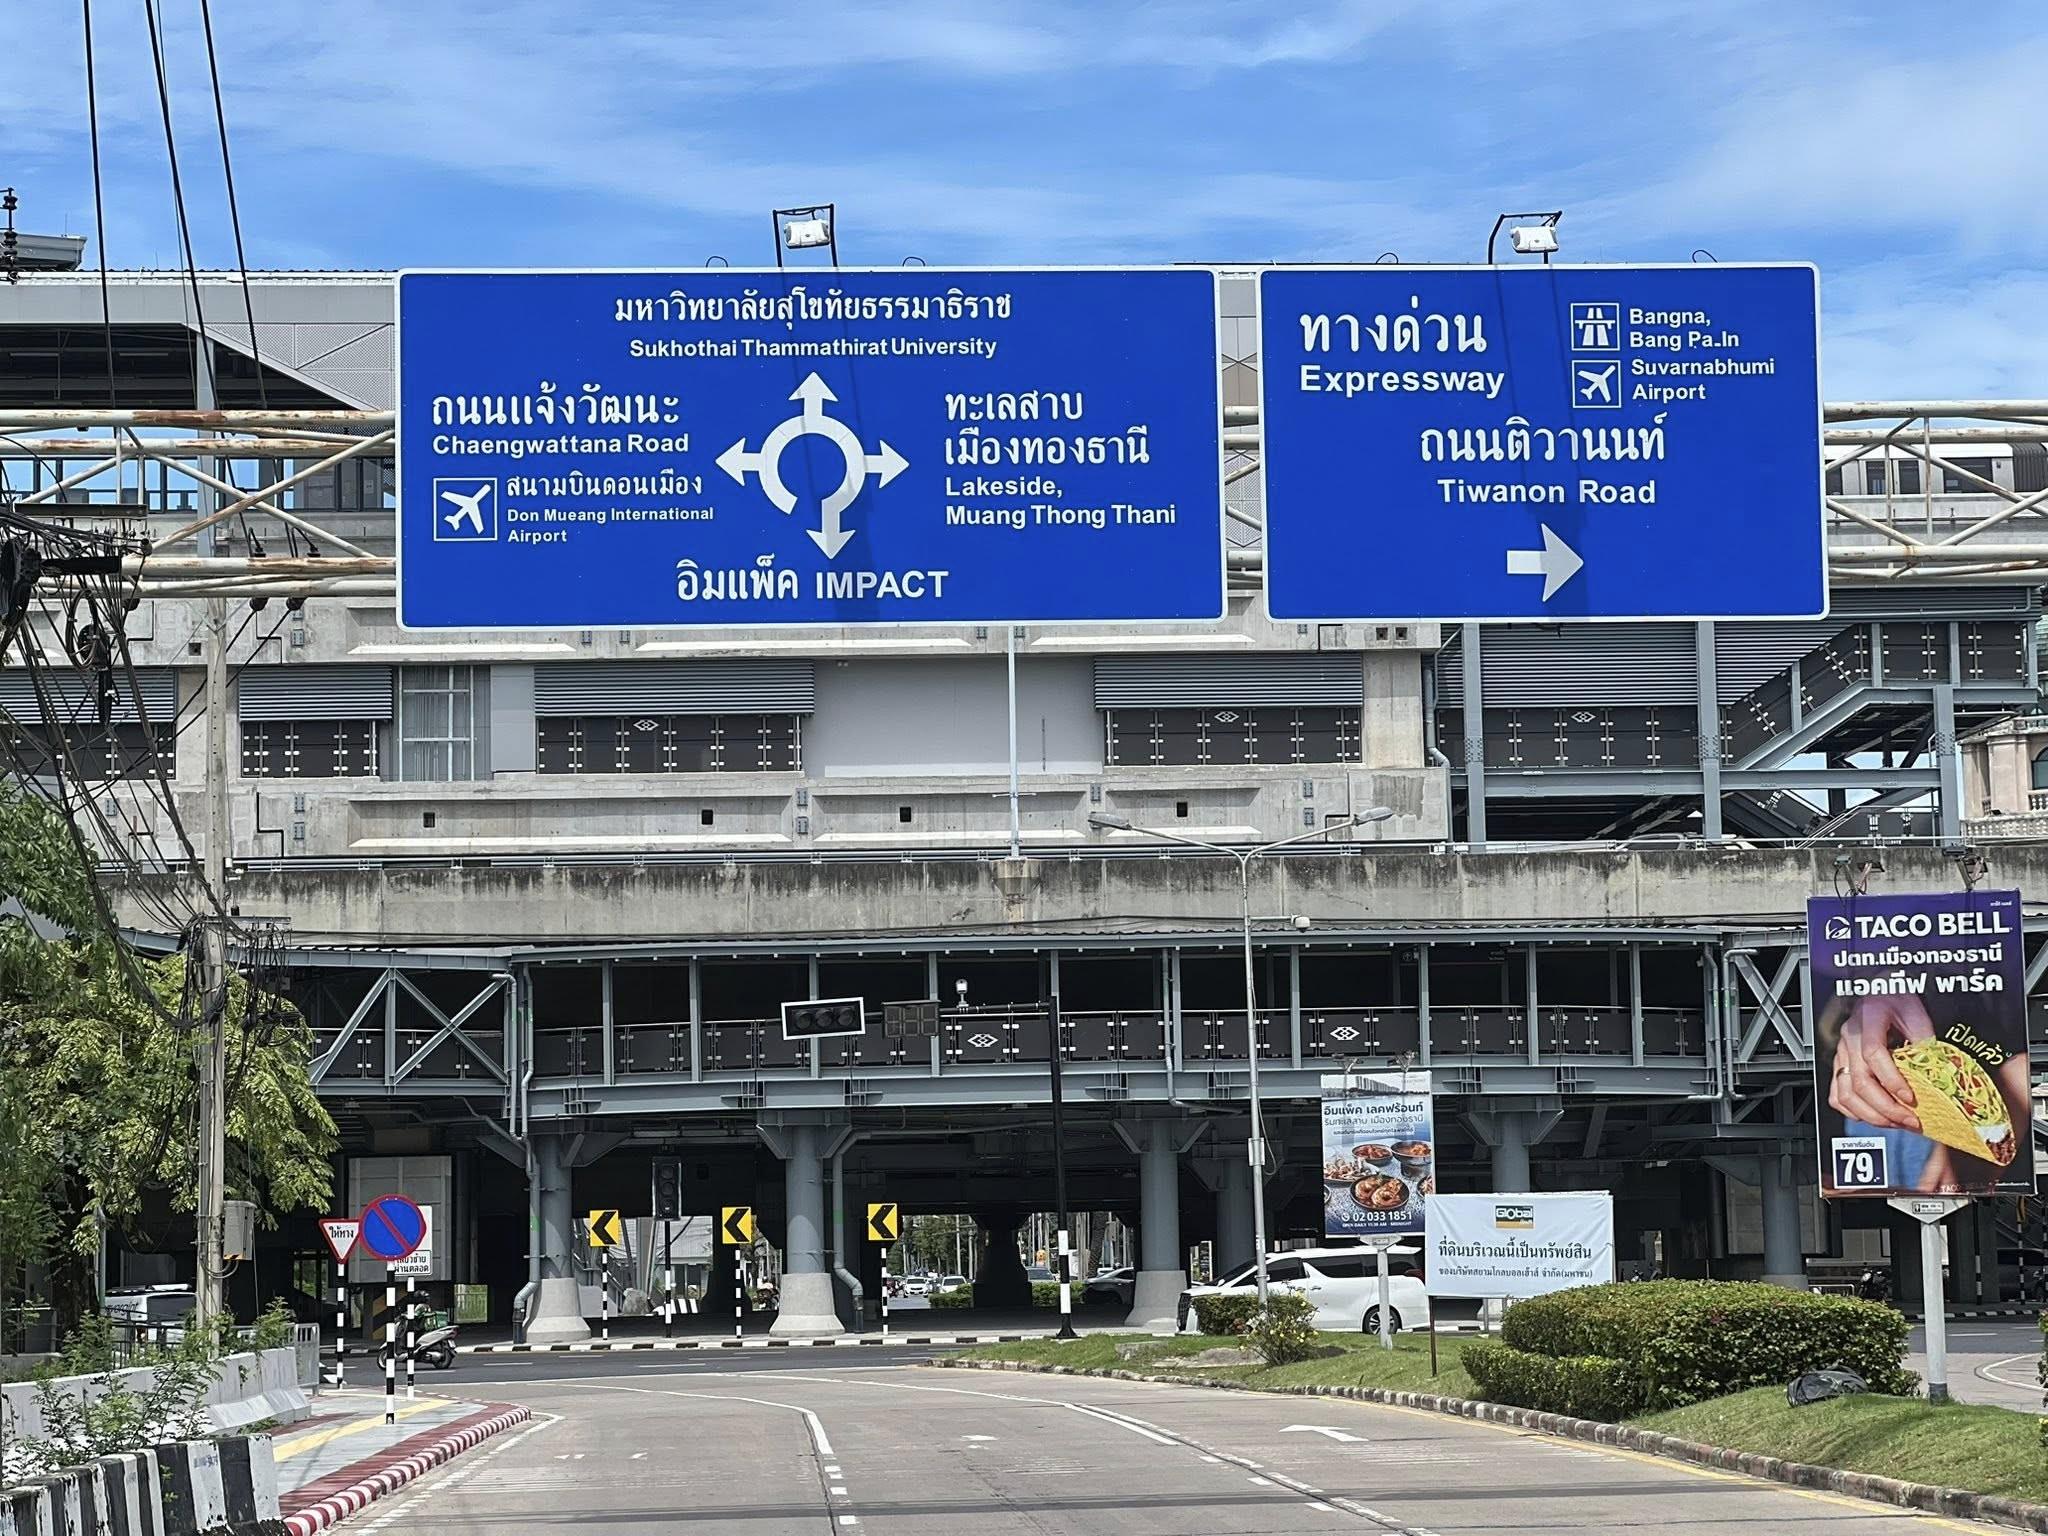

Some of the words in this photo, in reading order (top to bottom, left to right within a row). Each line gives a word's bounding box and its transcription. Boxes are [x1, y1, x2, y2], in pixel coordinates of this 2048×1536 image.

[615, 286, 1011, 330] มหาวิทยาลัยสุโขทัยธรรมาธิราช
[1629, 308, 1711, 329] Bangna,
[1299, 295, 1487, 353] ทางด่วน
[629, 339, 737, 357] Sukhothai
[740, 338, 888, 356] Thammathirat
[891, 337, 997, 359] University
[1629, 331, 1682, 352] Bang
[1631, 357, 1775, 376] Suvarnabhumi
[1300, 364, 1505, 399] Expressway
[1632, 383, 1706, 404] Airport
[432, 381, 679, 425] ถนนแจ้งวัฒนะ
[944, 389, 1083, 421] ทะเลสาบ
[432, 435, 621, 459] Chaengwattana
[627, 433, 689, 453] Road
[945, 424, 1150, 465] เมืองทองธานี
[1420, 411, 1668, 462] ถนนติวานนท์
[506, 467, 702, 497] สนามบินดอนเมือง
[946, 475, 1062, 498] Lakeside,
[1437, 478, 1565, 503] Tiwanon
[1579, 479, 1656, 504] Road
[507, 509, 539, 522] Don
[544, 508, 606, 525] Mueang
[611, 506, 714, 521] International
[946, 505, 1026, 530] Muang
[1030, 504, 1106, 529] Thong
[1111, 504, 1176, 524] Thani
[507, 529, 567, 545] Airport
[676, 553, 799, 601] อิมแพ็ค
[816, 570, 949, 599] IMPACT
[1854, 913, 1932, 939] TACO
[1937, 911, 2010, 936] BELL
[1833, 942, 2003, 967] ปตท.เมืองทองธานี
[1835, 969, 1927, 997] แอคทีฟ
[1935, 967, 2003, 993] พาร์ค
[1945, 1023, 2004, 1065] เปิดแล้ว
[1324, 1104, 1362, 1115] อิมแพ็ค
[1366, 1101, 1423, 1114] เลคฟร้อนท์
[1353, 1212, 1365, 1221] 02
[1367, 1211, 1386, 1221] 033
[1388, 1211, 1412, 1220] 1851
[329, 1226, 354, 1238] ให้ทาง
[1439, 1236, 1592, 1259] ที่ดินบริเวณนี้เป็นทรัพย์สิน
